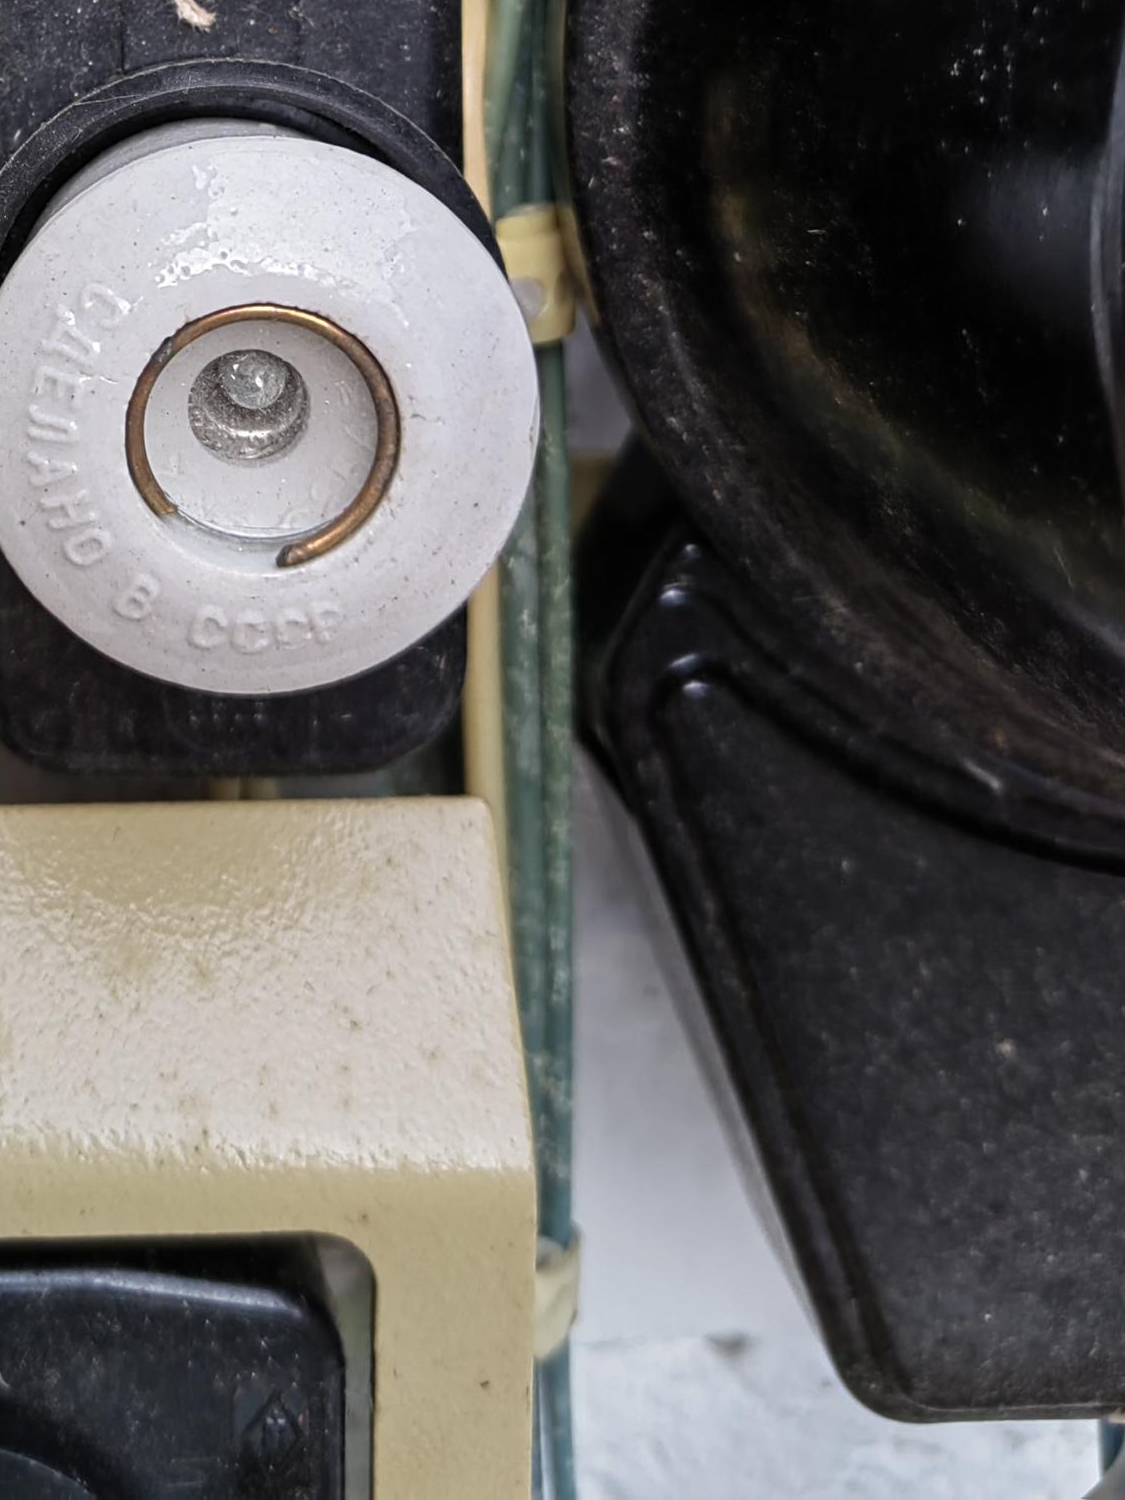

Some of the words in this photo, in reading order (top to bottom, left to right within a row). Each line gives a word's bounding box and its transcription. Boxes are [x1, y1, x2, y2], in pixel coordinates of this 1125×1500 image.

[26, 280, 135, 568] СДЕЛАНО
[113, 574, 162, 621] В
[187, 600, 345, 654] СССР
